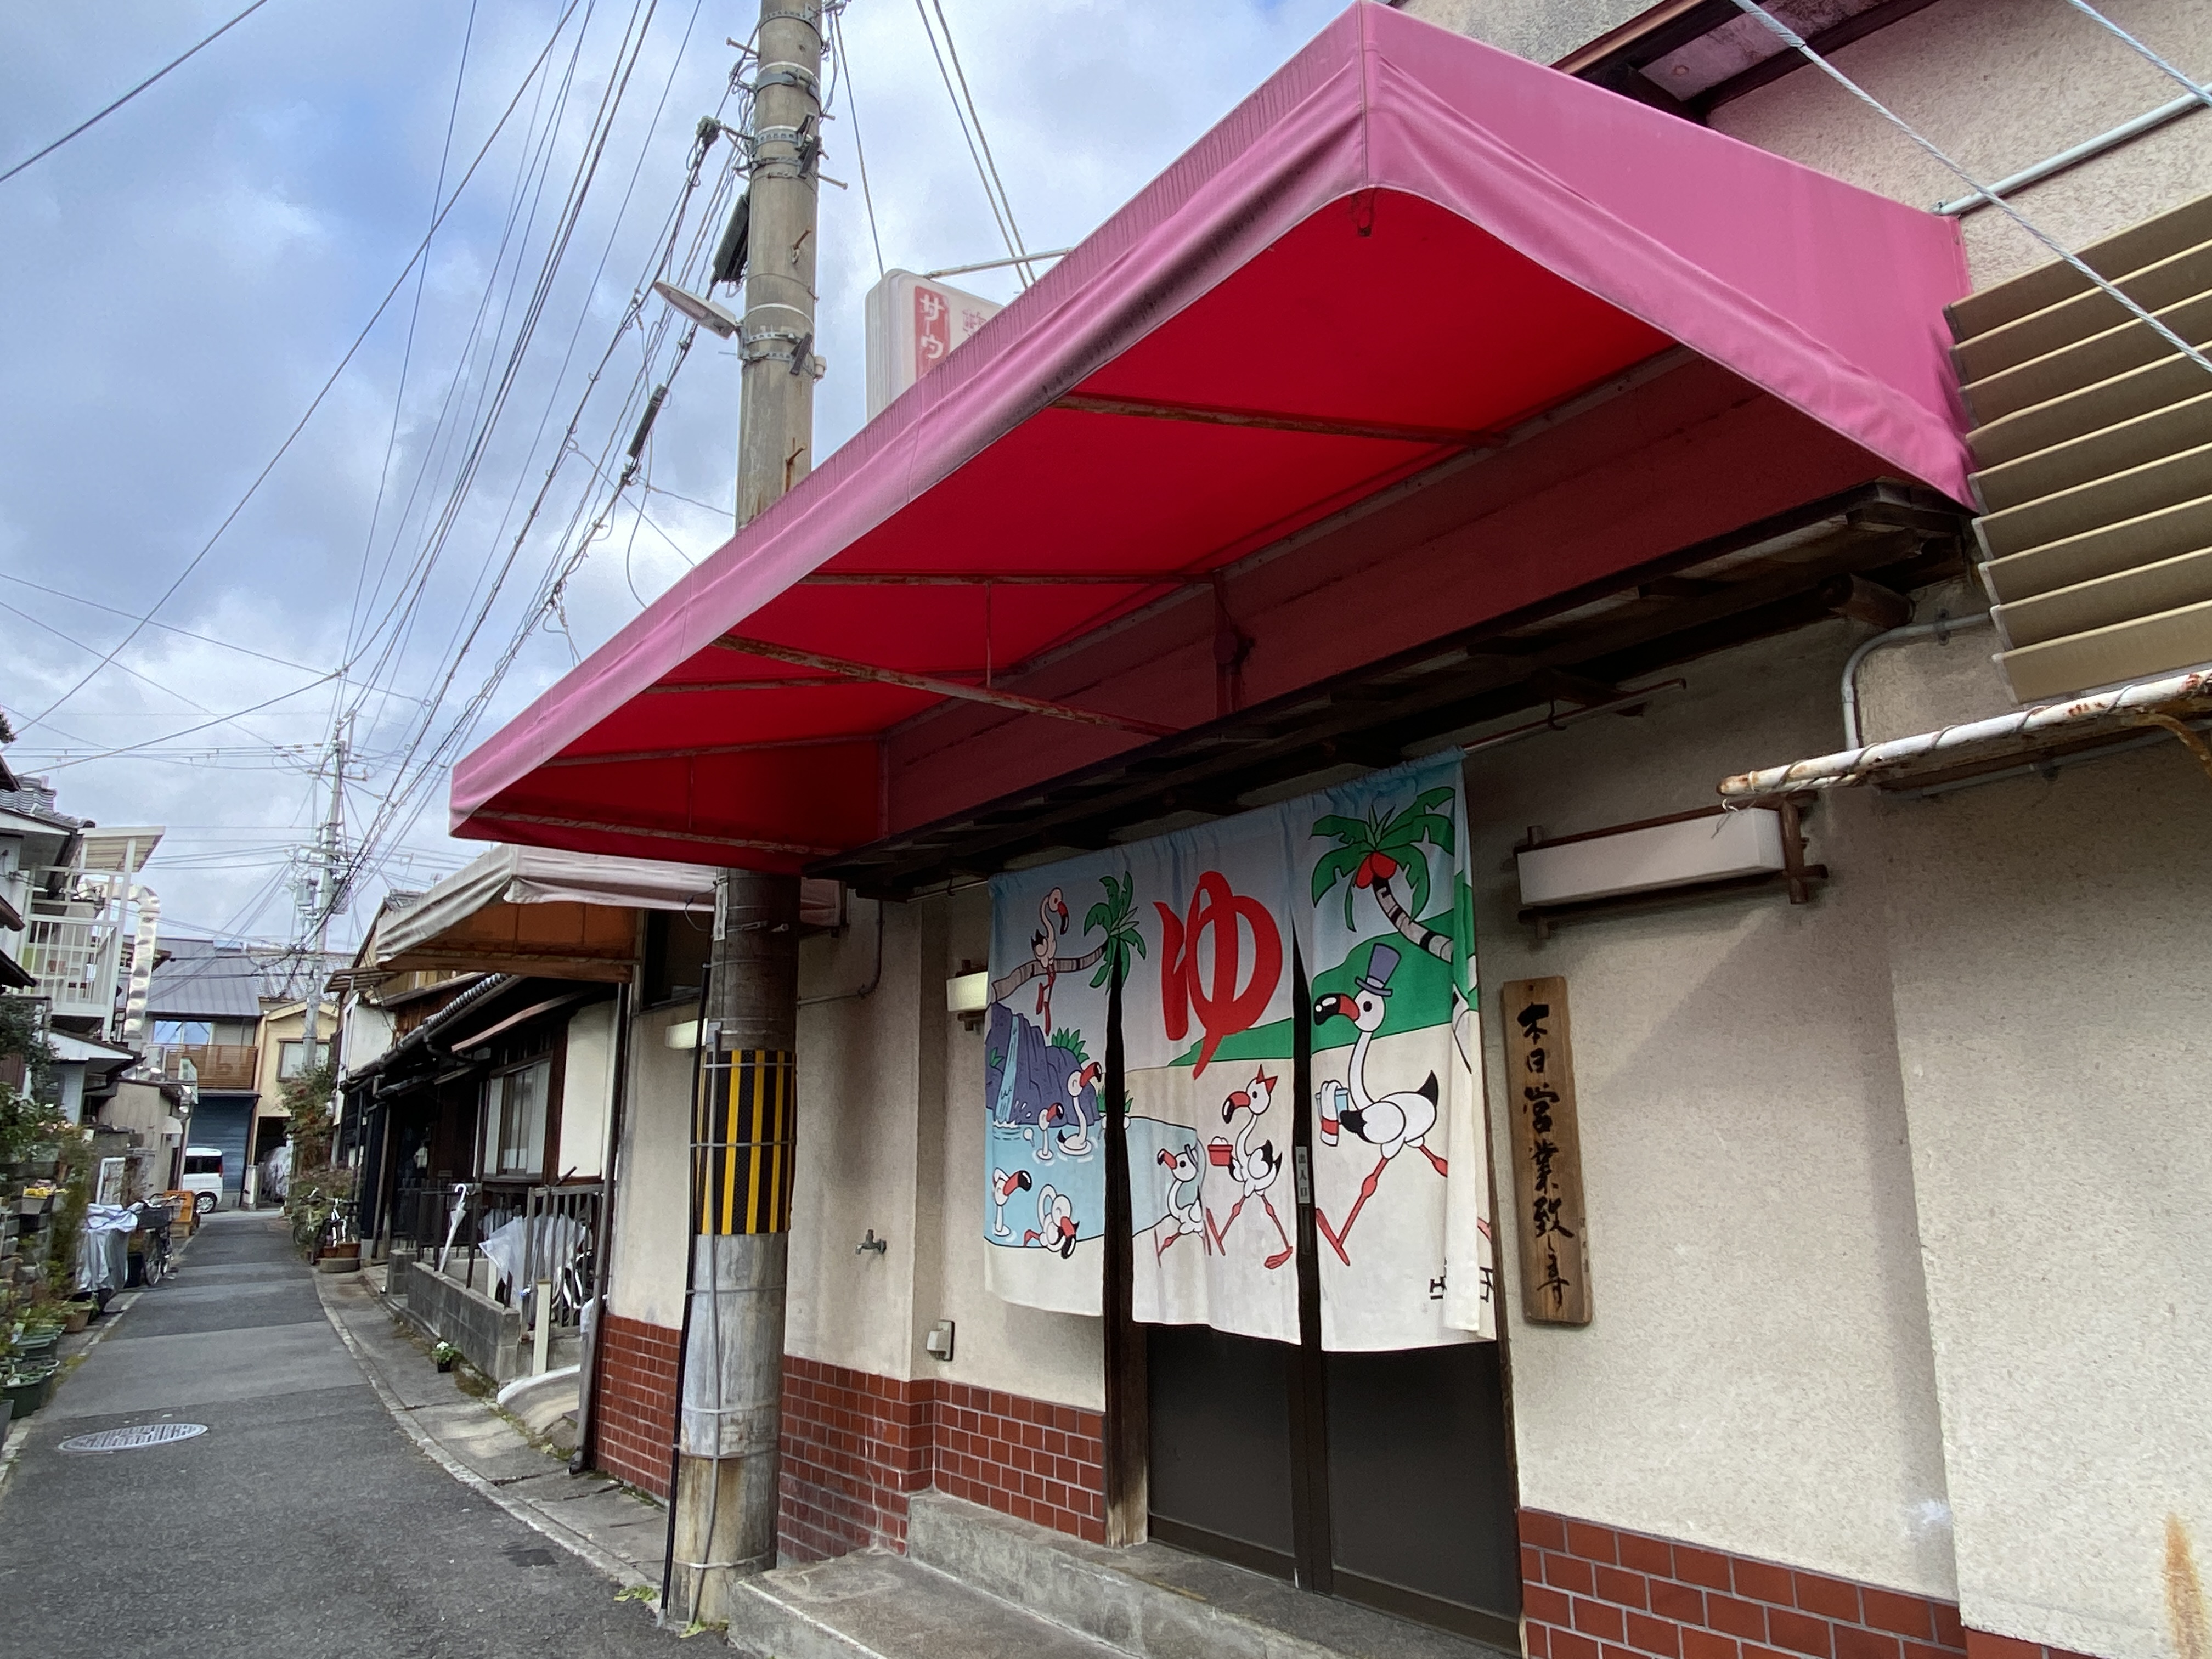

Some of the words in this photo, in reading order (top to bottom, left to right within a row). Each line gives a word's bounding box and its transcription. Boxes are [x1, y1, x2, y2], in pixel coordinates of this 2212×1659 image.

[1152, 870, 1283, 1080] ゆ
[1298, 1153, 1308, 1197] 出入口
